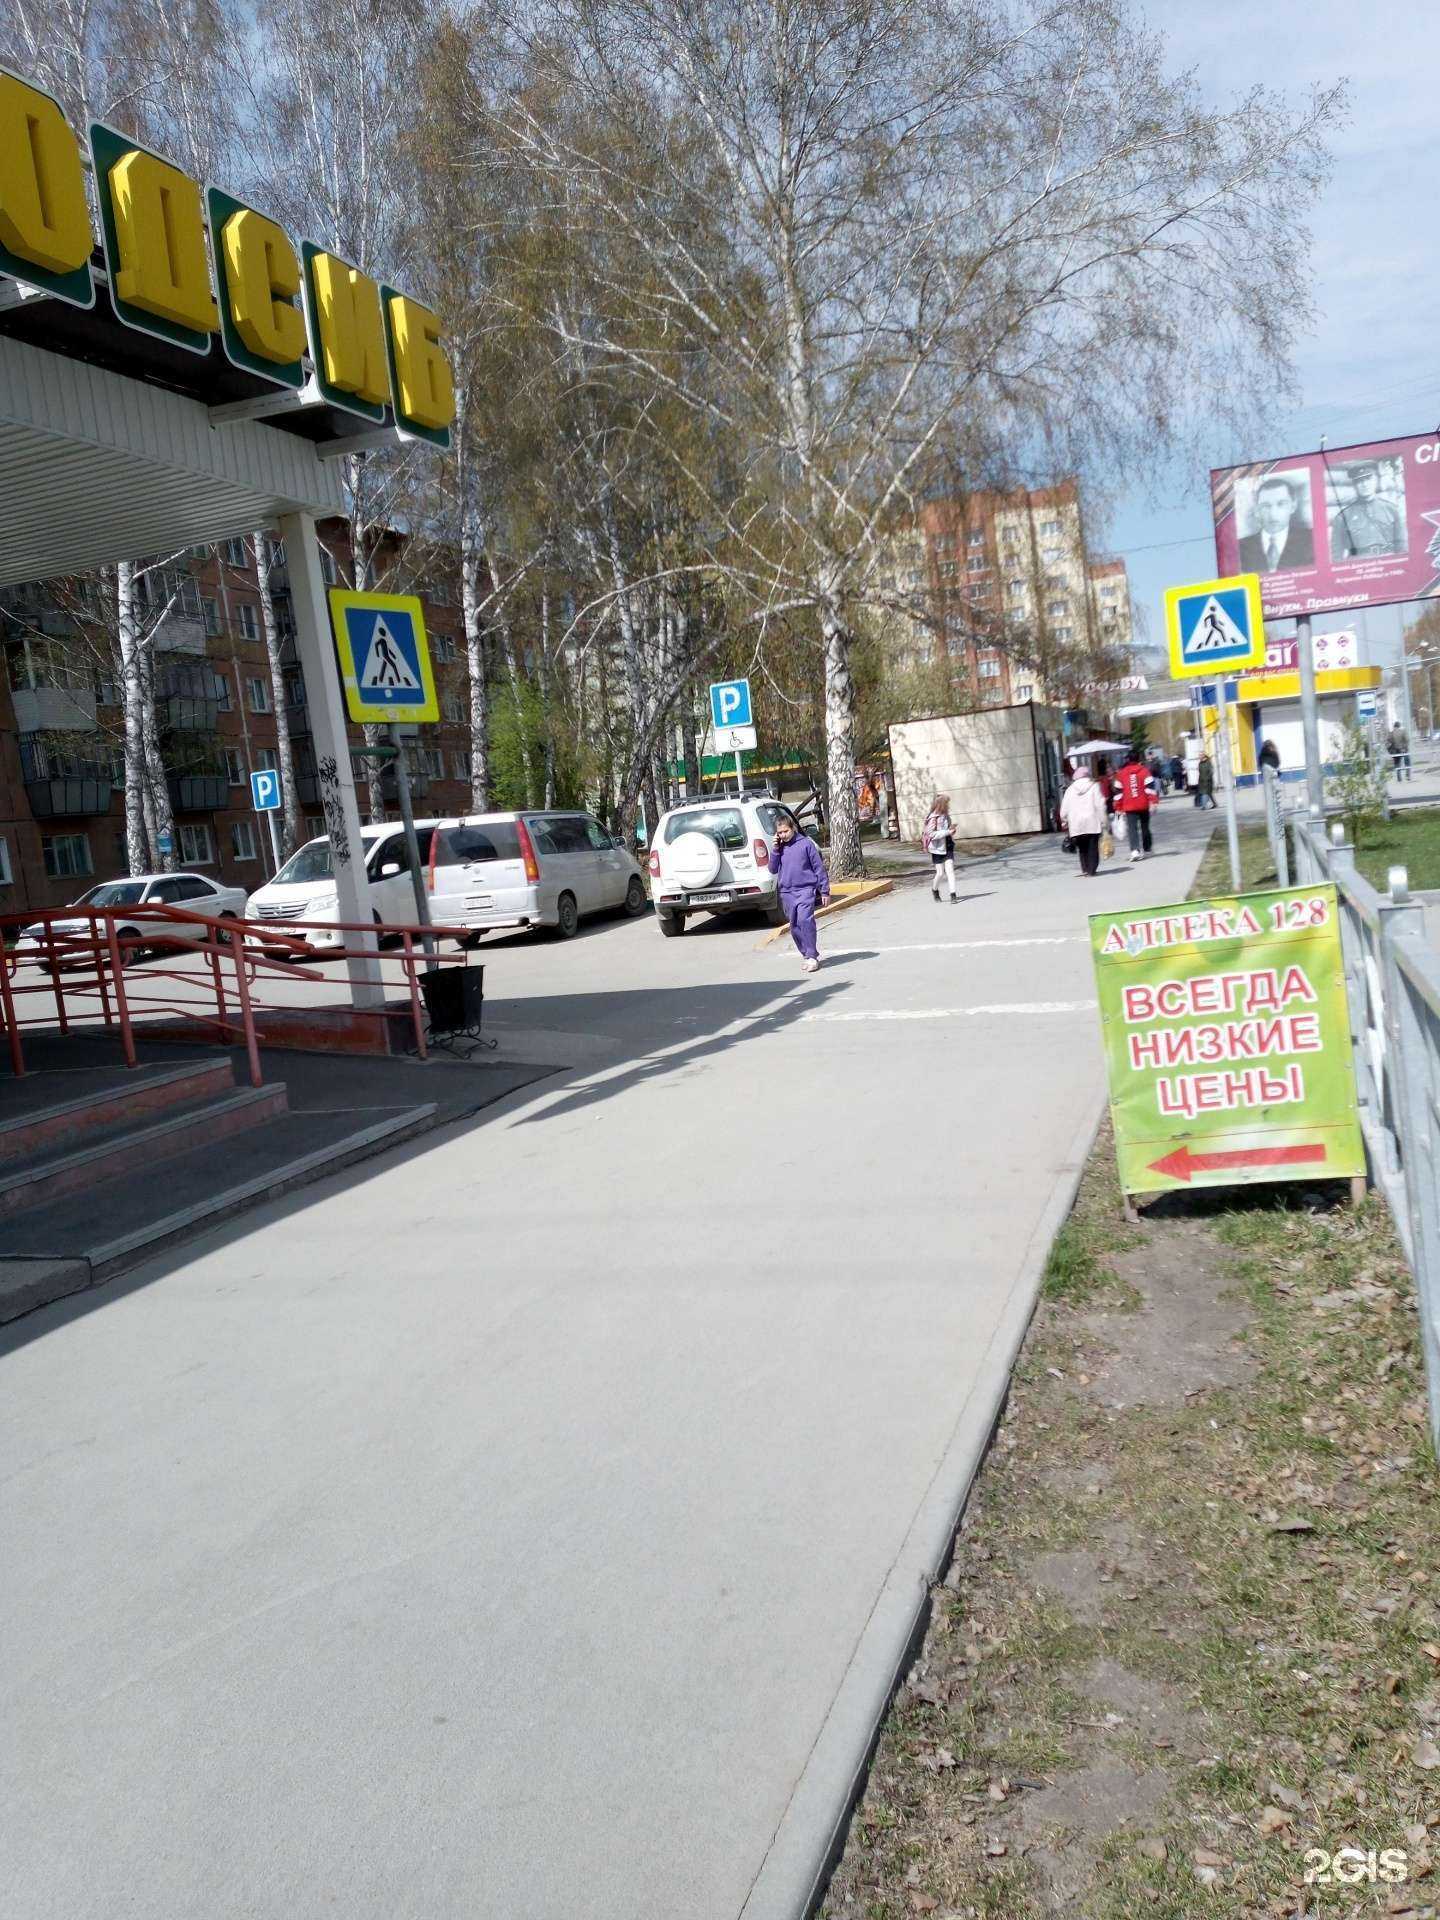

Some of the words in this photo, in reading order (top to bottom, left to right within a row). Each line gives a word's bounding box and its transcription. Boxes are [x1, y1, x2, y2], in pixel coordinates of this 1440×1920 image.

[719, 687, 741, 724] P
[256, 775, 273, 806] P
[1102, 906, 1262, 953] АПТЕКА
[1271, 900, 1329, 931] 128
[1123, 966, 1316, 1022] ВСЕГДА
[1130, 1015, 1321, 1069] НИЗКИЕ
[1158, 1066, 1303, 1117] ЦЕНЫ
